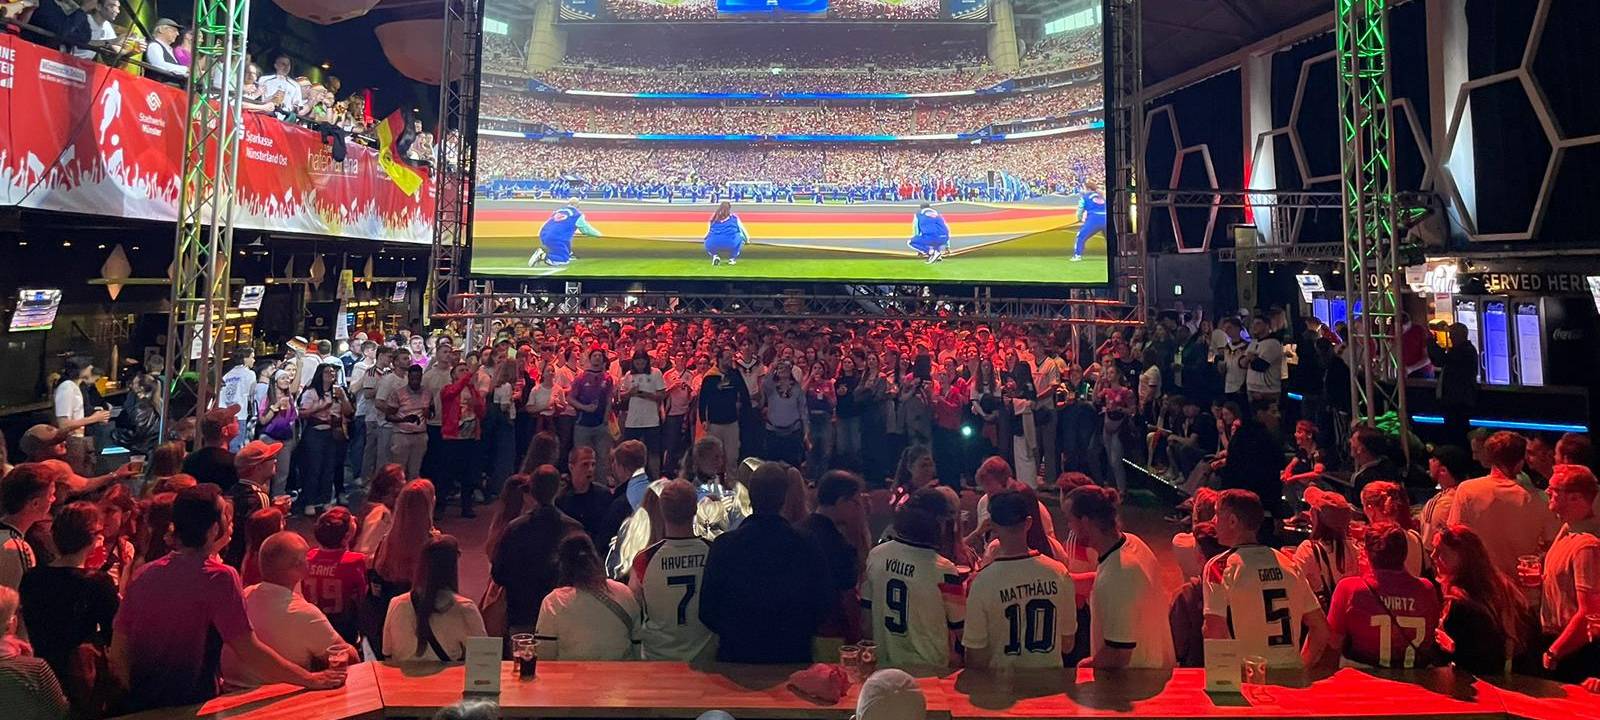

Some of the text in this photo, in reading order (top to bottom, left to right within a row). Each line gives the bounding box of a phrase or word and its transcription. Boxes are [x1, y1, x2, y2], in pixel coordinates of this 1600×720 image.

[245, 130, 273, 147] Sparkasse
[661, 555, 706, 570] HAVERTZ
[885, 559, 915, 577] VÖLLER
[667, 575, 696, 625] 7
[884, 578, 909, 636] 9
[1000, 579, 1057, 603] MATTHÄUS
[1004, 598, 1057, 656] 10
[1262, 588, 1294, 646] 5
[1370, 614, 1426, 669] 17
